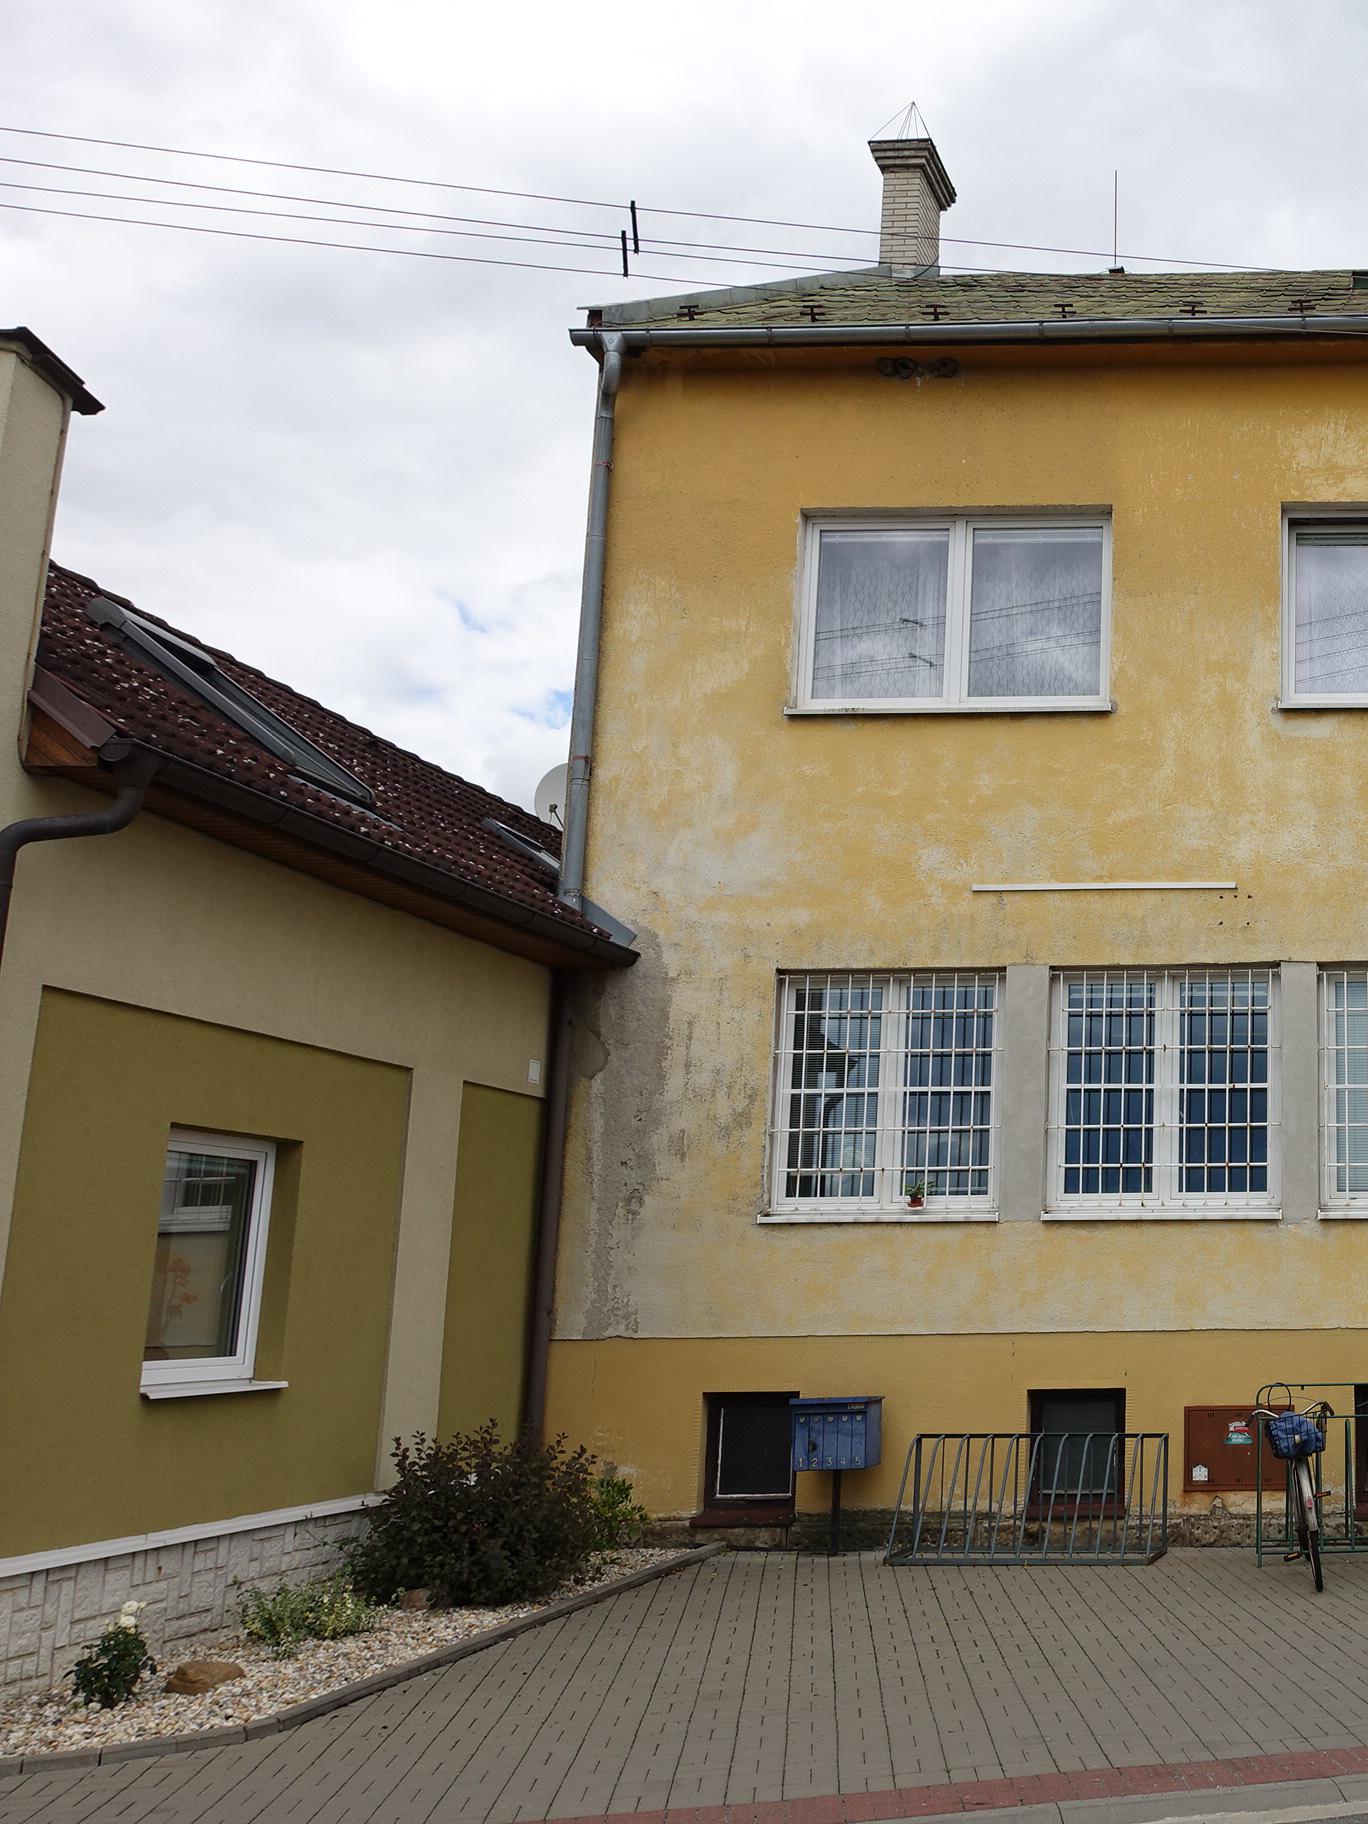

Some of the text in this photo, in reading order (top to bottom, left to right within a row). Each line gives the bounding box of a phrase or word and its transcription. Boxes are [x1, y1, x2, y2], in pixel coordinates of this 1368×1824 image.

[811, 1457, 818, 1467] 2
[826, 1456, 833, 1466] 3
[840, 1456, 846, 1465] 4
[855, 1456, 861, 1465] 5
